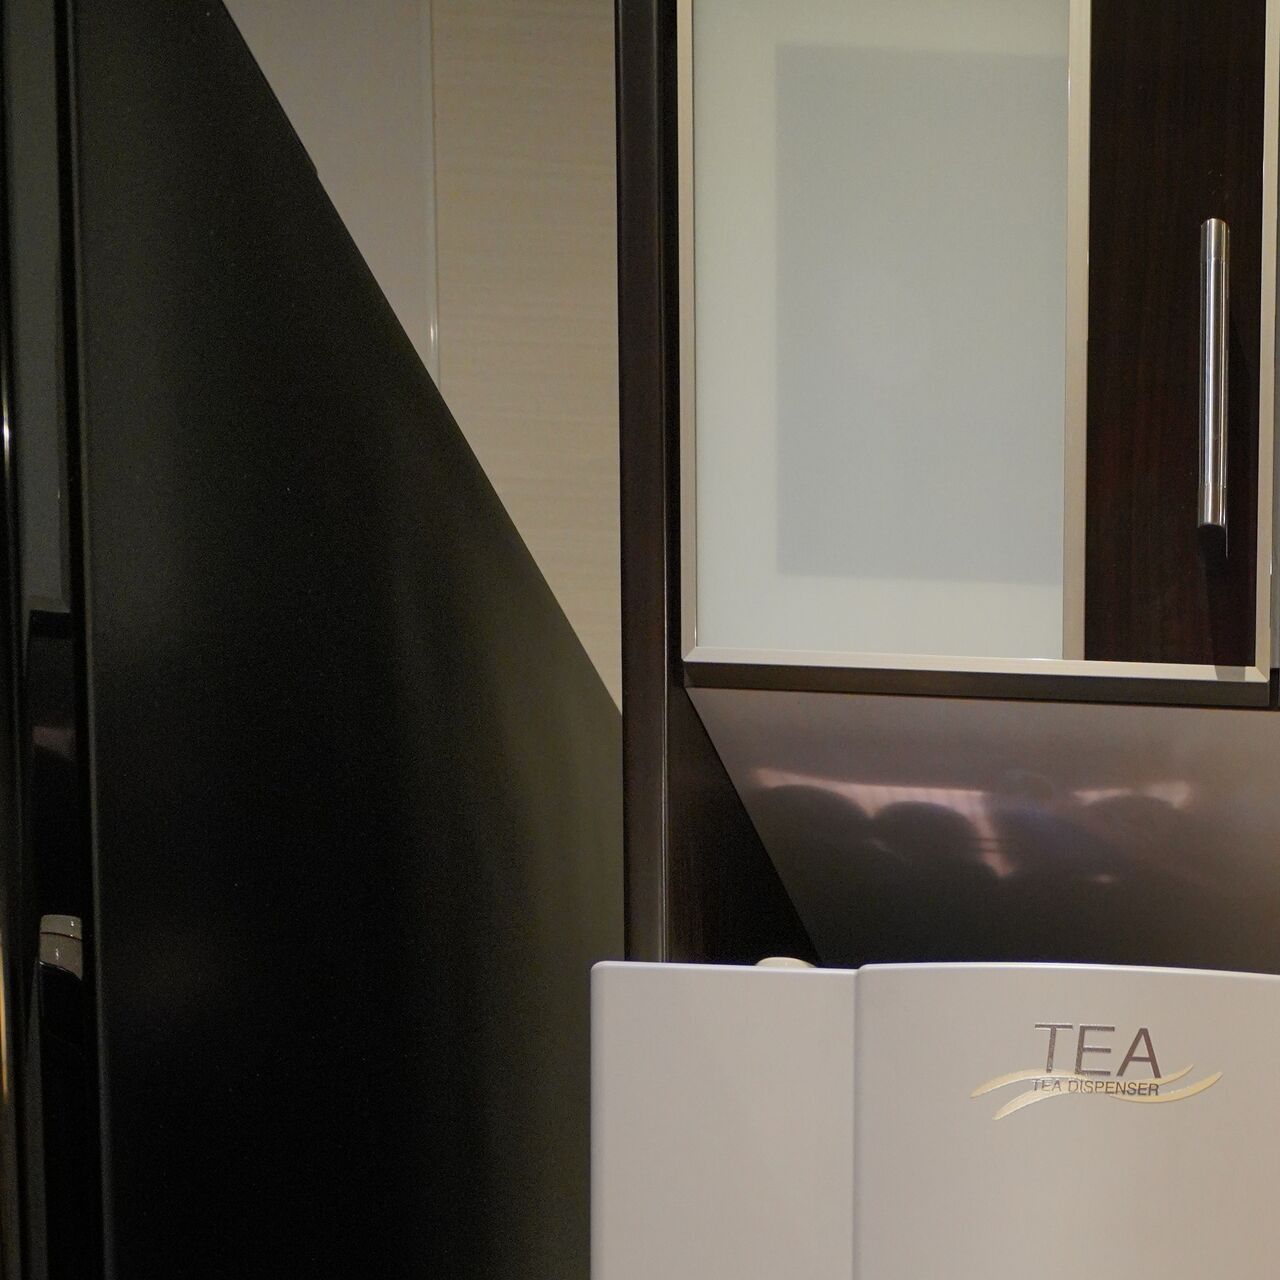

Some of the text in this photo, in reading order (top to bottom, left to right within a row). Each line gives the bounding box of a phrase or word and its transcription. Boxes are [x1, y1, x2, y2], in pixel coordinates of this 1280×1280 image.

[1034, 1022, 1162, 1079] TEA
[1031, 1078, 1160, 1097] TEA DISPENSER
